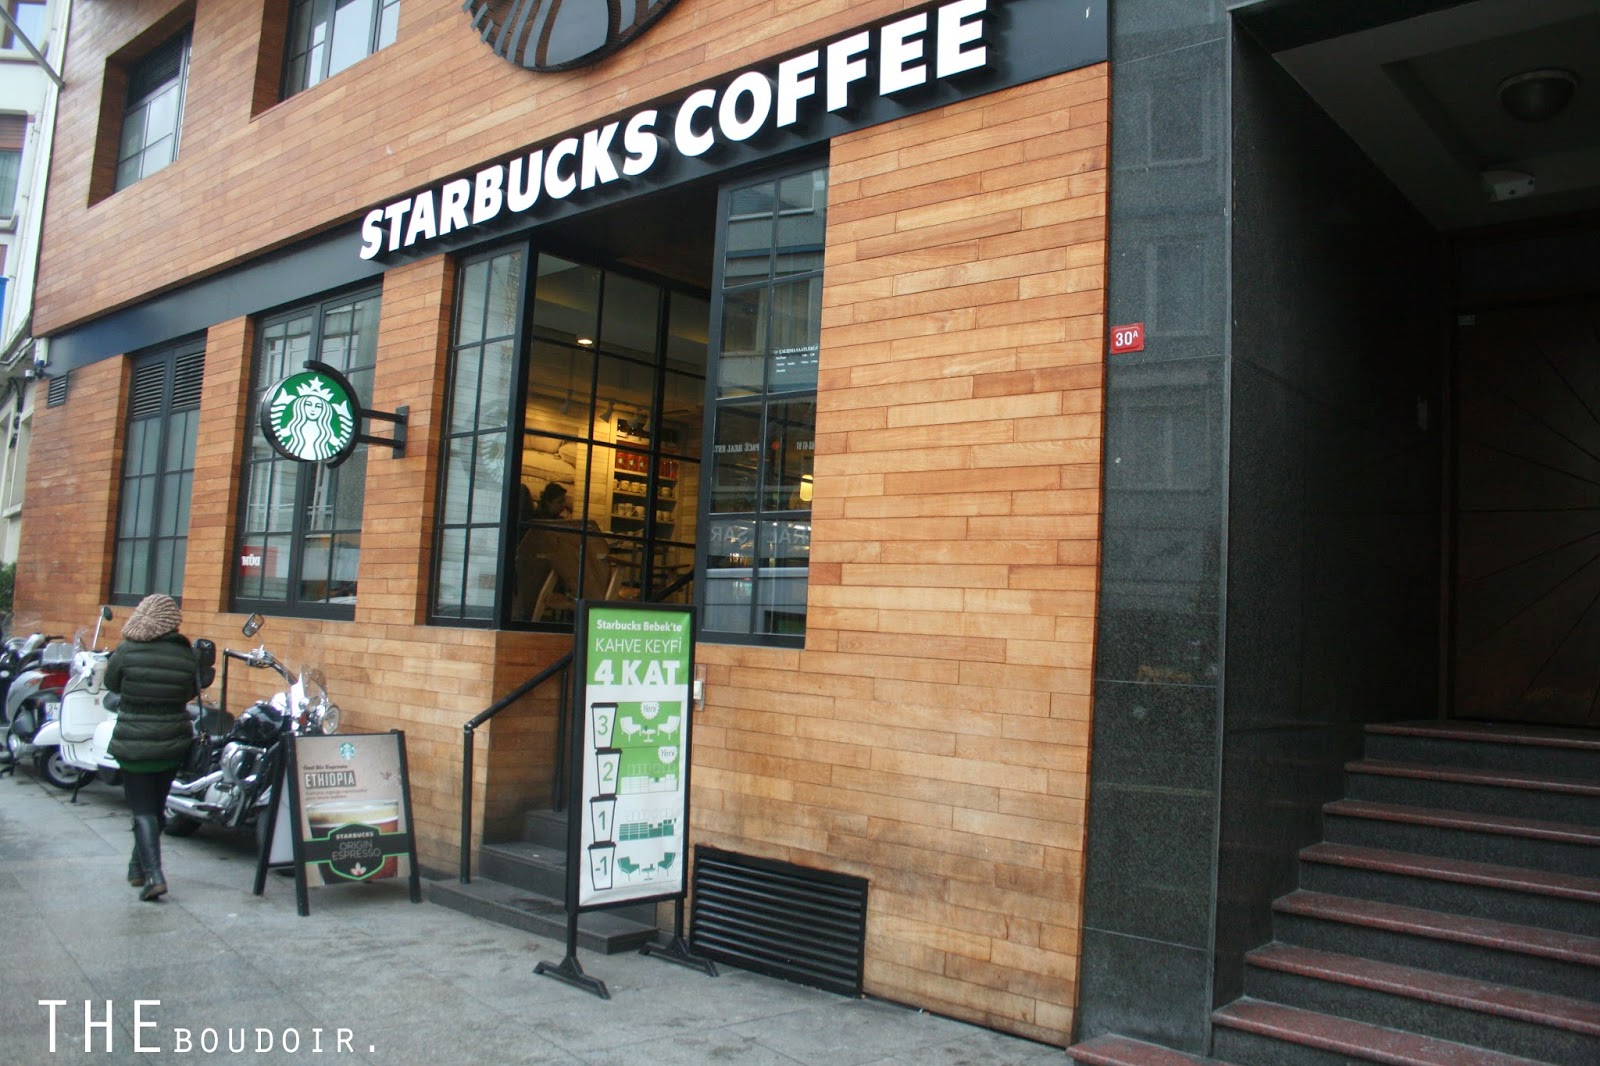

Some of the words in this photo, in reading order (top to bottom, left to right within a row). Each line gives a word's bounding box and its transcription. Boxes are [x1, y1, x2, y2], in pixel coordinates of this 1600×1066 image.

[360, 109, 659, 261] STARBUCKS
[674, 0, 988, 157] COFFEE
[1115, 330, 1139, 347] 30A
[596, 619, 641, 631] Starbucks
[643, 621, 682, 632] Bebek'te
[595, 638, 641, 653] KAHVE
[645, 637, 682, 653] KEYFİ
[594, 659, 614, 686] 4
[621, 659, 680, 686] KAT
[643, 704, 657, 713] Yeni
[597, 715, 608, 735] 3
[660, 749, 675, 758] Yeni
[305, 772, 355, 788] ETHIOPIA
[602, 762, 614, 782] 2
[598, 811, 606, 830] 1
[335, 831, 374, 840] STARBUCKS
[339, 840, 373, 851] ORIGIN
[332, 848, 381, 860] ESPRESSO
[595, 856, 607, 876] -1
